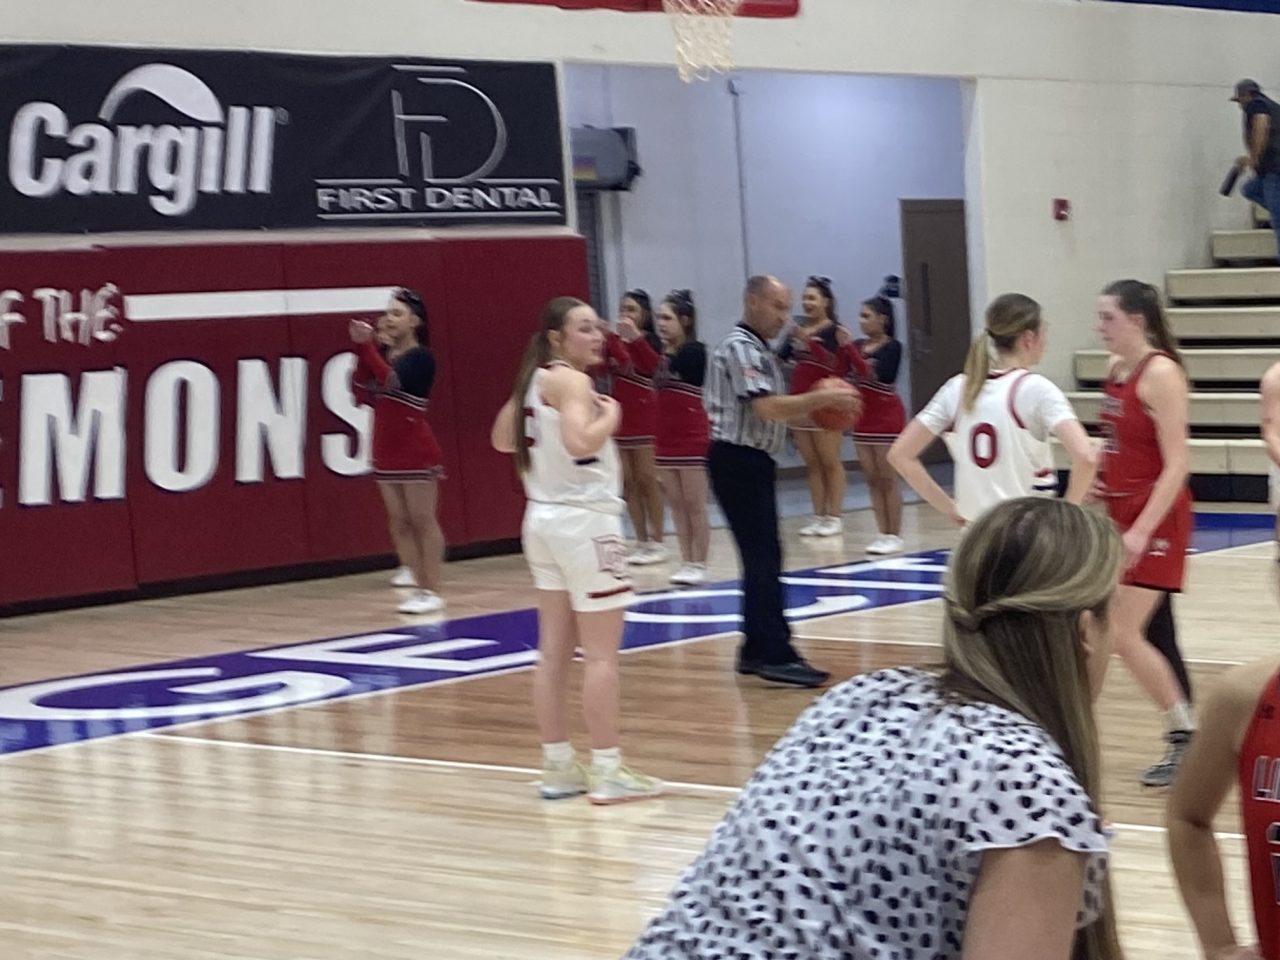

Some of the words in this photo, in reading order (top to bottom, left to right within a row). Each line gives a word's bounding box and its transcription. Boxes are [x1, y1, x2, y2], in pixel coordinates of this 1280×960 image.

[8, 100, 276, 217] Cargill
[316, 187, 416, 212] FIRST
[424, 187, 562, 210] DENTAL
[32, 281, 124, 347] THE
[0, 350, 375, 506] MONS
[968, 421, 999, 469] 0
